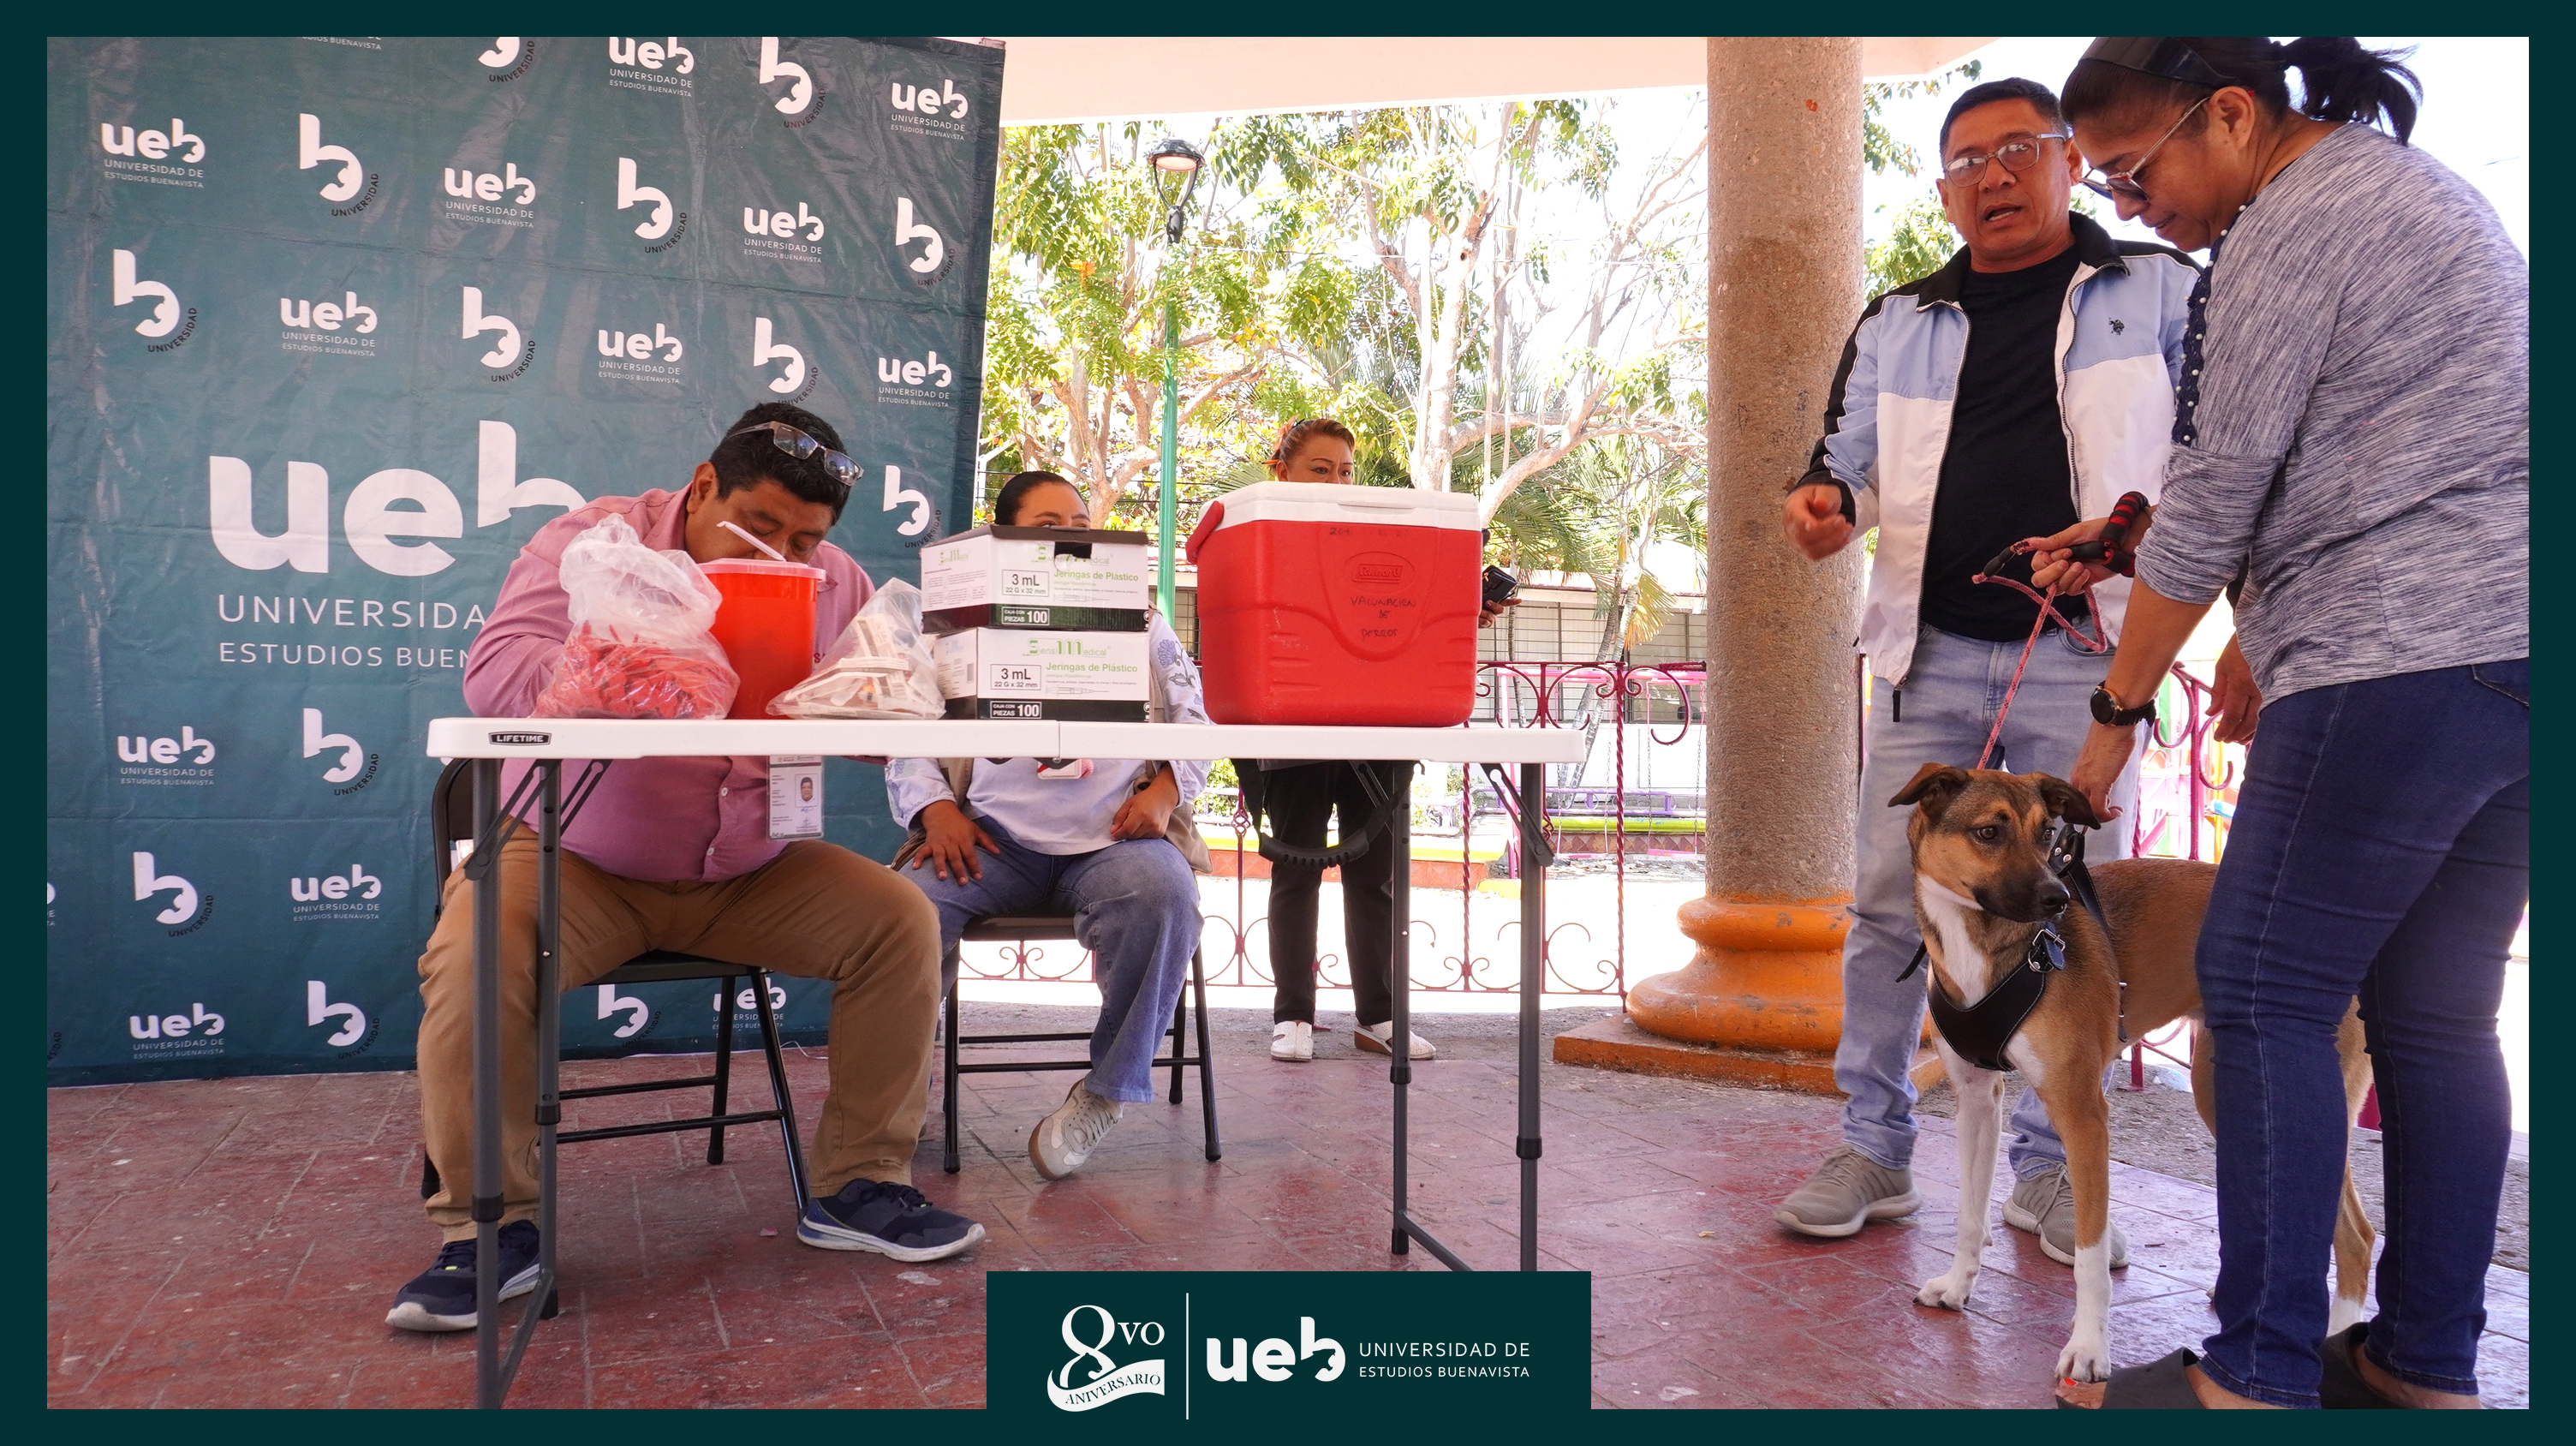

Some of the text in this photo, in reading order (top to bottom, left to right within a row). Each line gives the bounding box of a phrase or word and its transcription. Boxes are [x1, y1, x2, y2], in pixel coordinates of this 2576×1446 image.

[489, 40, 535, 82] UNIVERSIDAD
[609, 37, 695, 75] ueb
[610, 68, 692, 88] UNIVERSIDAD DE
[609, 79, 692, 98] ESTUDIOS BUENAVISTA
[784, 87, 826, 128] UNIVERSIDAD
[891, 79, 969, 119] ueb
[891, 113, 965, 132] UNIVERSIDAD DE
[891, 124, 965, 140] ESTUDIOS BUENAVISTA
[101, 118, 206, 163] ueb
[104, 159, 204, 178] UNIVERSIDAD DE
[104, 171, 204, 188] ESTUDIOS BUENAVISTA
[444, 163, 536, 205] ueb
[331, 173, 379, 218] UNIVERSIDAD
[446, 200, 534, 218] UNIVERSIDAD DE
[445, 212, 534, 228] ESTUDIOS BUENAVISTA
[743, 201, 825, 242] ueb
[644, 212, 688, 254] UNIVERSIDAD
[744, 238, 822, 254] UNIVERSIDAD DE
[744, 248, 822, 264] ESTUDIOS BUENAVISTA
[917, 248, 956, 287] UNIVERSIDAD
[281, 291, 377, 334] ueb
[147, 308, 198, 353] UNIVERSIDAD
[282, 332, 375, 348] UNIVERSIDAD DE
[282, 343, 375, 357] ESTUDIOS BUENAVISTA
[599, 323, 683, 362] ueb
[491, 340, 535, 383] UNIVERSIDAD
[599, 361, 665, 374] UNIVERSIDAD
[878, 350, 951, 387] ueb
[599, 372, 680, 384] ESTUDIOS BUENAVISTA
[879, 386, 937, 399] UNIVERSIDAD
[878, 397, 949, 408] ESTUDIOS BUENAVISTA
[904, 509, 941, 548] UNIVERSIDAD
[1011, 574, 1040, 586] 3 mL
[1054, 571, 1090, 580] Jeringas
[1106, 571, 1139, 582] Plástico
[218, 595, 486, 630] UNIVERSIDA
[1027, 610, 1047, 623] 100
[220, 642, 383, 667] ESTUDIOS
[1001, 667, 1031, 679] 3 mL
[1046, 662, 1085, 672] Jeringas
[1102, 662, 1137, 672] Plástico
[1017, 704, 1040, 717] 100
[117, 726, 215, 764] ueb
[121, 768, 214, 777] UNIVERSIDAD DE
[334, 753, 379, 796] UNIVERSIDAD
[291, 863, 381, 902] ueb
[169, 894, 214, 937] UNIVERSIDAD
[293, 903, 363, 913] UNIVERSIDAD
[293, 913, 331, 922] ESTUDIOS
[129, 1003, 224, 1039] ueb
[133, 1039, 211, 1050] UNIVERSIDAD
[338, 1018, 380, 1060] UNIVERSIDAD
[133, 1049, 224, 1060] ESTUDIOS BUENAVISTA
